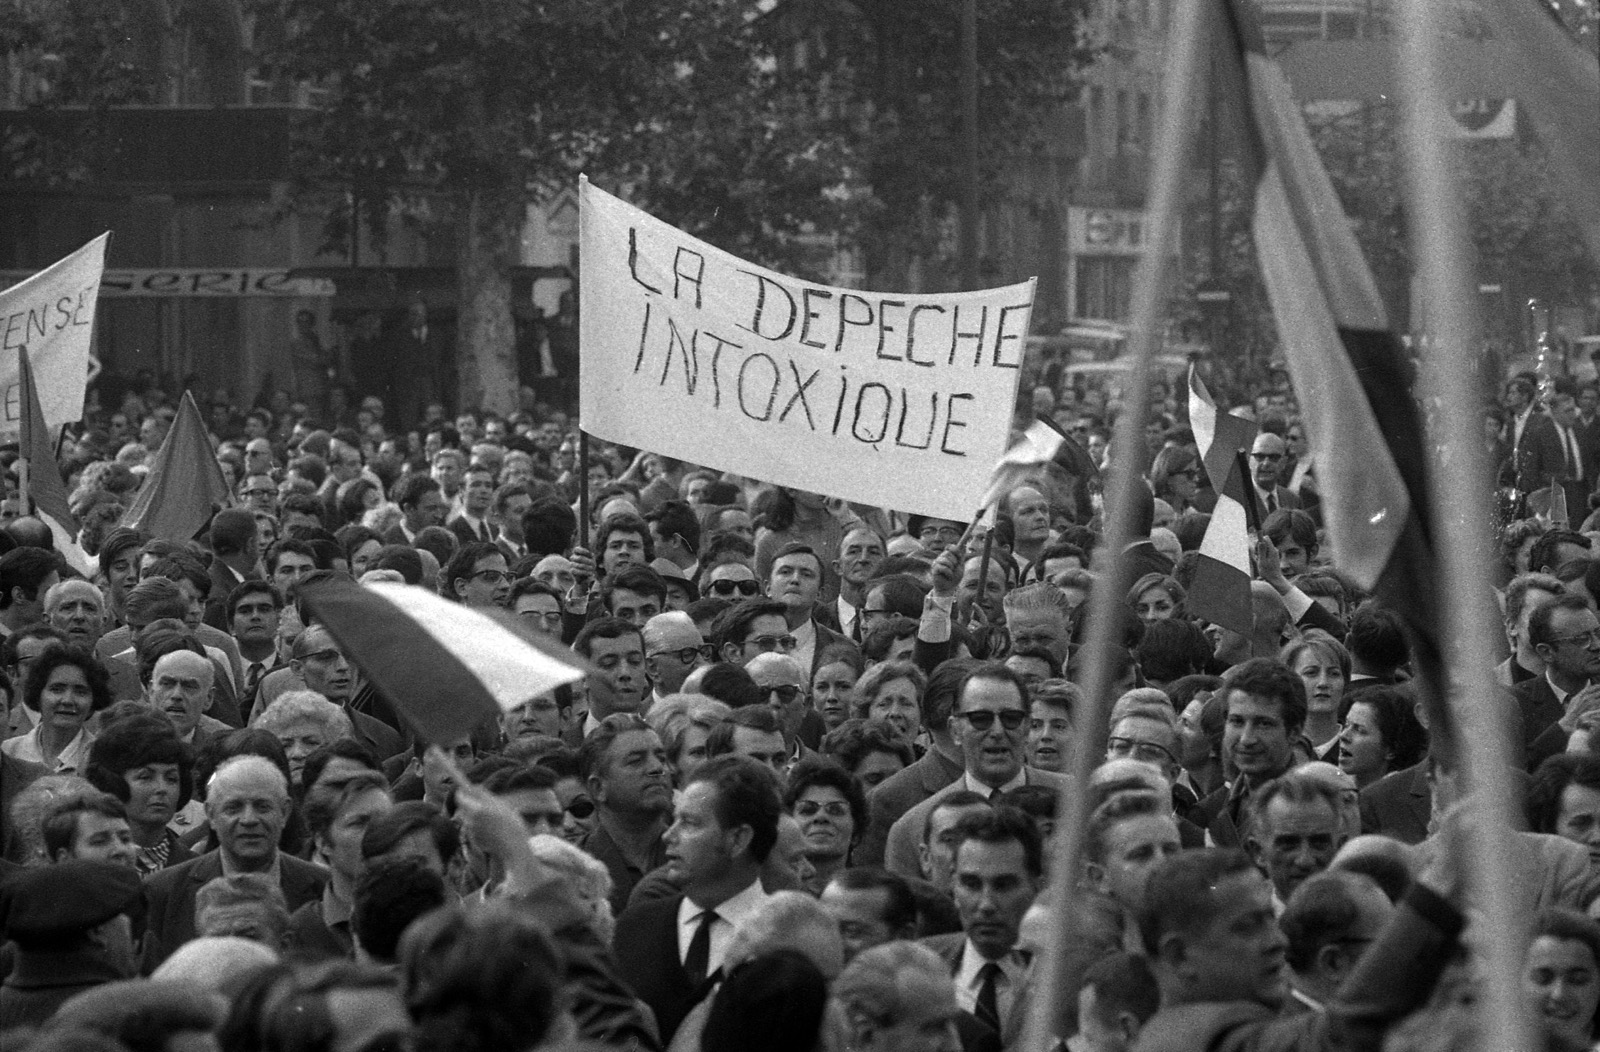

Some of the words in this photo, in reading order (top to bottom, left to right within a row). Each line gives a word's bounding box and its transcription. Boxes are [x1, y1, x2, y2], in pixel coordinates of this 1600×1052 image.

[0, 287, 94, 350] ENSE
[628, 227, 704, 309] LA
[736, 269, 1032, 369] DEPECHE
